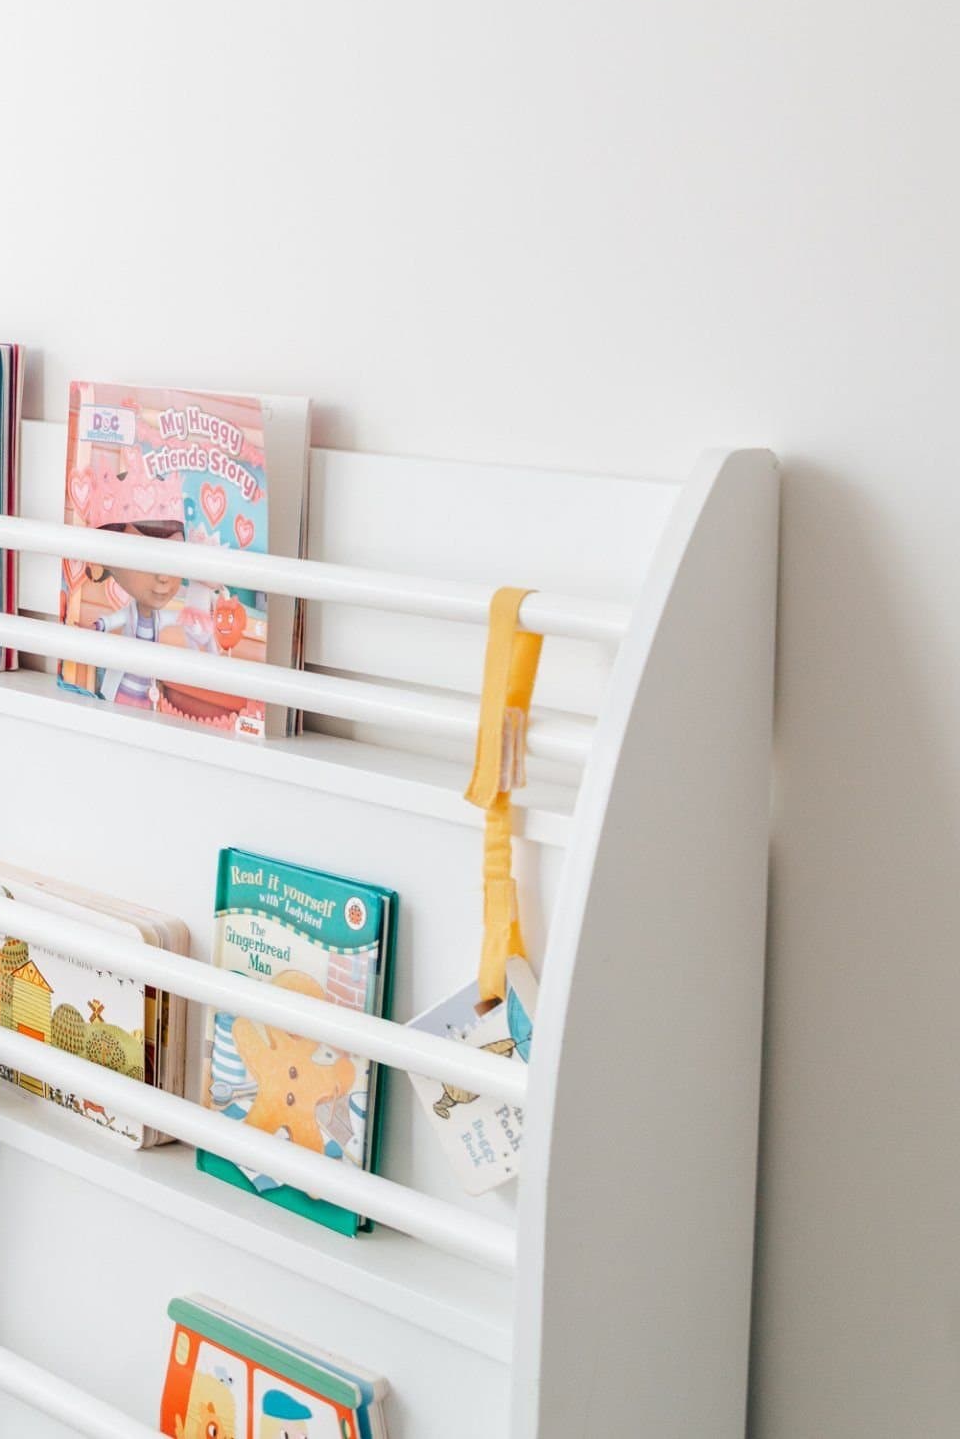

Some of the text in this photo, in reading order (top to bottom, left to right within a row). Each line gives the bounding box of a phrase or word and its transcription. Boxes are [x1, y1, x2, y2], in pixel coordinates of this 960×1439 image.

[159, 407, 244, 454] My Huggy
[144, 446, 257, 502] Friends Story
[231, 865, 336, 919] Read it yourself
[259, 893, 323, 931] with Ladybird
[225, 925, 291, 962] Gingerbread
[250, 921, 266, 937] The
[248, 953, 272, 975] Man
[495, 1103, 522, 1152] Pooh
